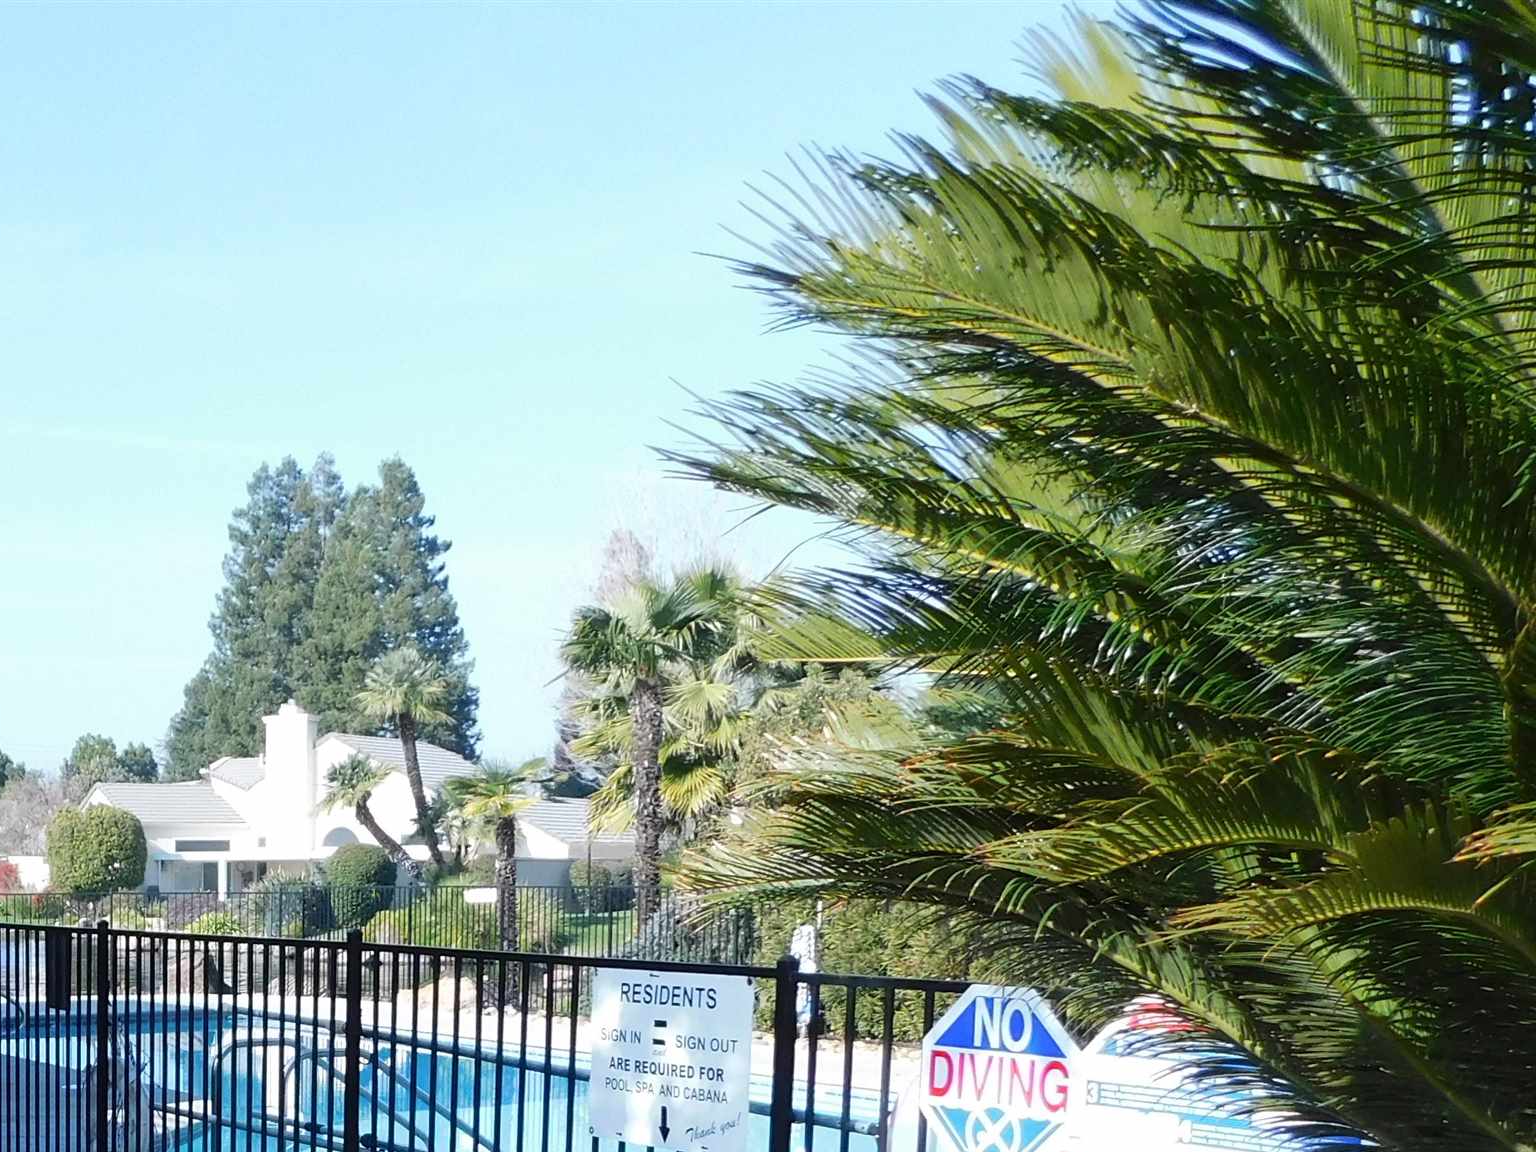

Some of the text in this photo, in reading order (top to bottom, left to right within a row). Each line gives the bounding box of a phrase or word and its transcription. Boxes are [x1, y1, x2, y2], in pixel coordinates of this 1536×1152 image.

[620, 982, 717, 1009] RESIDENTS
[600, 1027, 641, 1044] SIGN IN
[973, 996, 1032, 1052] NO
[675, 1034, 738, 1054] SIGN OUT
[609, 1056, 724, 1082] ARE REQUIRED FOR
[929, 1049, 1069, 1113] DIVING
[659, 1085, 680, 1099] AND
[683, 1086, 728, 1104] CABANA
[685, 1121, 716, 1143] Thank
